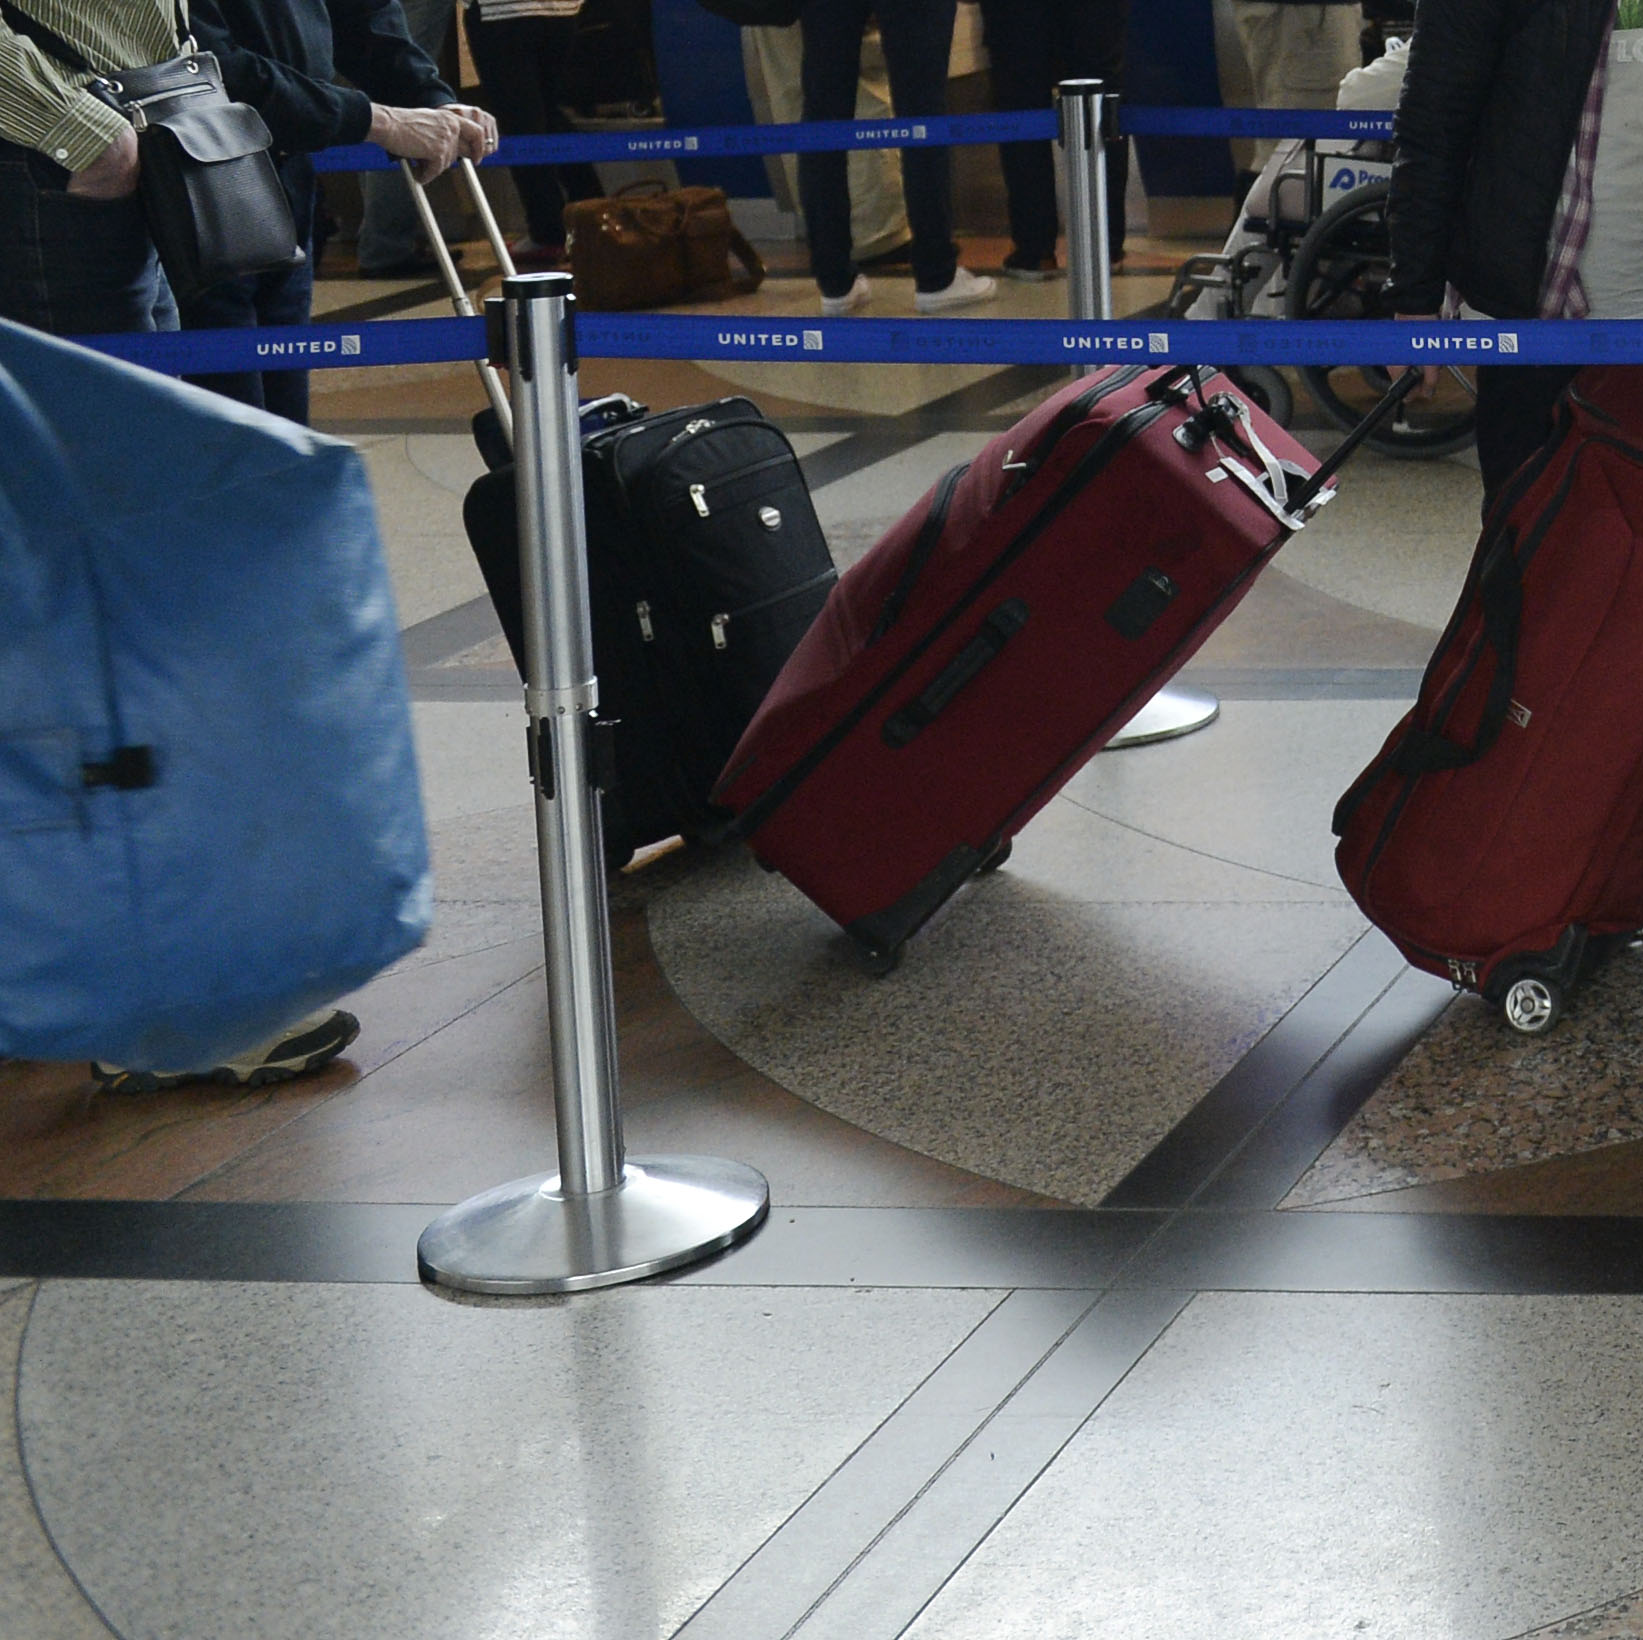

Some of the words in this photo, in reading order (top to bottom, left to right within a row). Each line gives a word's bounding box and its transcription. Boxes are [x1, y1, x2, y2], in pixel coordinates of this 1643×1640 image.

[1348, 121, 1393, 130] UNITE
[856, 129, 909, 139] UNITED
[629, 140, 682, 150] UNITED
[717, 332, 798, 346] UNITED
[1062, 336, 1144, 350] UNITED
[1411, 337, 1493, 350] UNITED
[256, 340, 337, 356] UNITED
